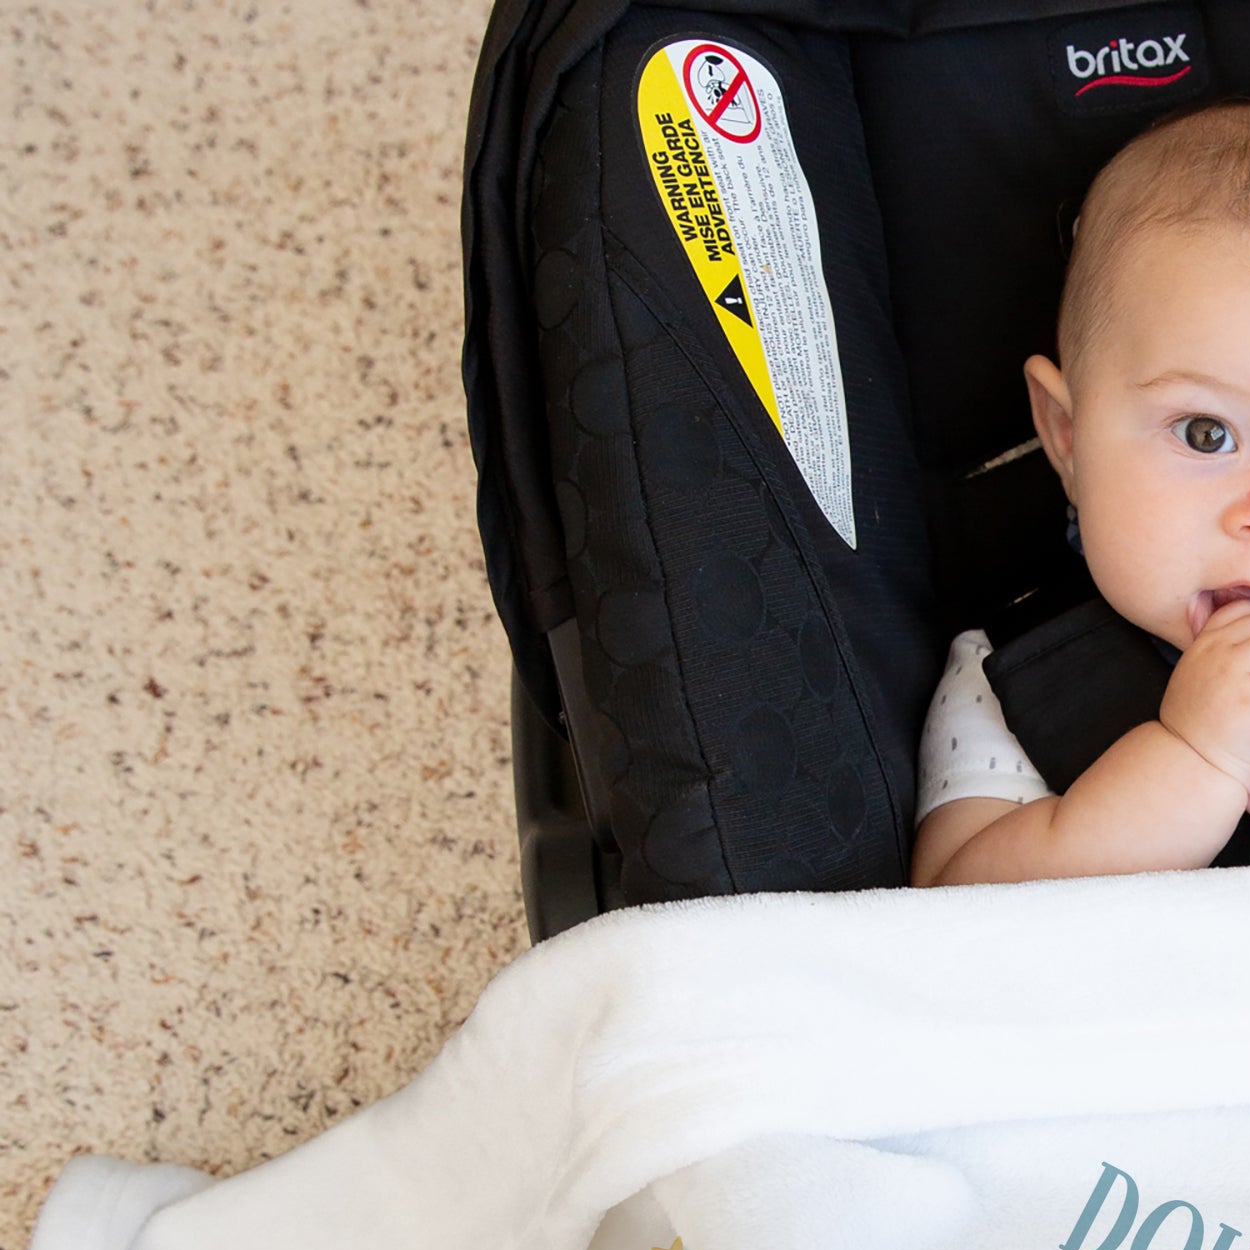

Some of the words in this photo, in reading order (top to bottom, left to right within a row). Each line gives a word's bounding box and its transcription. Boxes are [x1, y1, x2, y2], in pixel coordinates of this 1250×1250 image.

[1066, 33, 1190, 78] britax
[655, 112, 693, 177] GARDE
[653, 151, 698, 242] WARNING
[678, 118, 736, 256] ADVERTENCIA
[683, 183, 703, 209] EN
[695, 215, 722, 262] MISE
